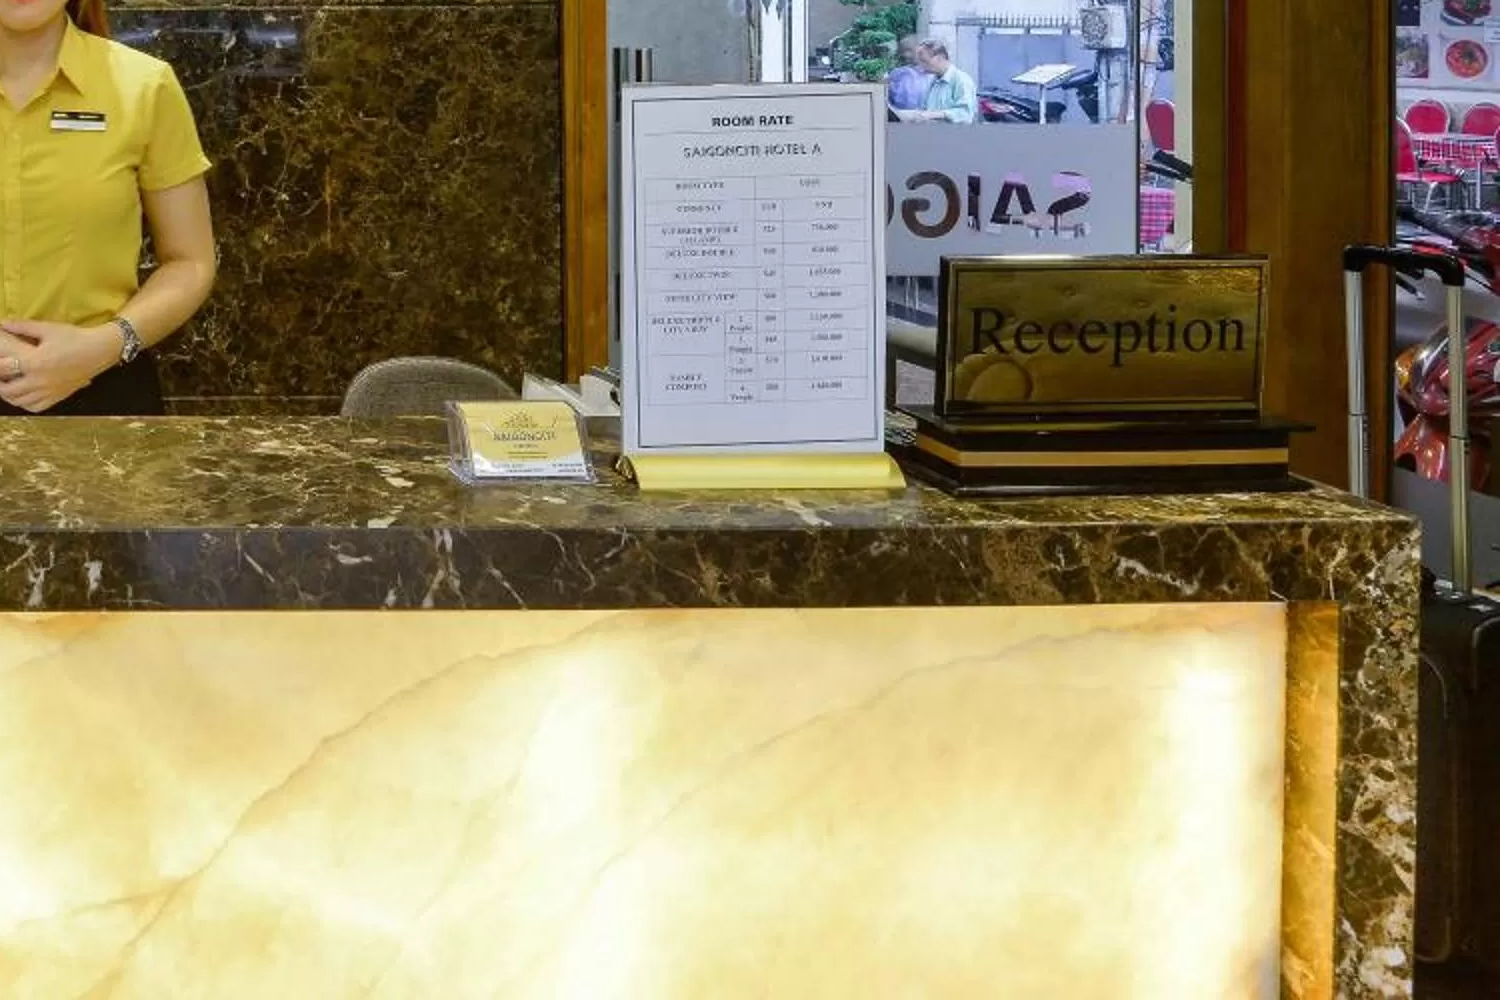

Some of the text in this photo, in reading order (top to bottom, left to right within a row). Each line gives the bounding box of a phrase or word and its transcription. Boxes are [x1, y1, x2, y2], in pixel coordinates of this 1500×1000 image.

[711, 114, 794, 128] ROOM RATE
[764, 143, 807, 156] HOTEL
[970, 304, 1246, 368] Reception
